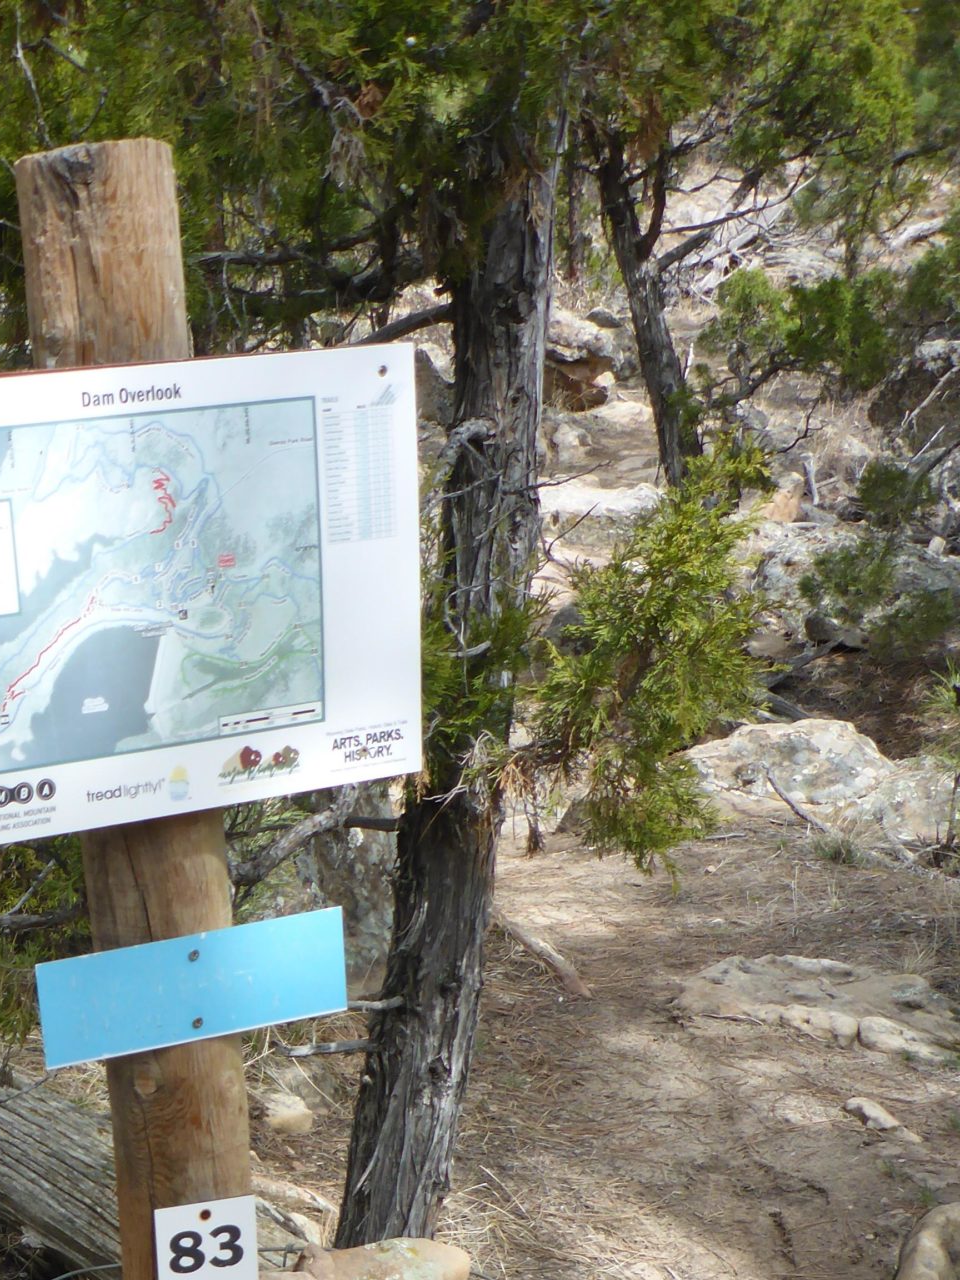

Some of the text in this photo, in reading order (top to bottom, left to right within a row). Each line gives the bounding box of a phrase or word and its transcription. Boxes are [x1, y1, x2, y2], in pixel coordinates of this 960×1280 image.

[81, 383, 182, 408] Dam Overlook
[332, 735, 363, 751] ARTS.
[365, 728, 404, 745] PARKS.
[23, 805, 57, 817] MOUNTAIN
[12, 817, 51, 830] ASSOCIATION
[169, 1224, 244, 1274] 83
